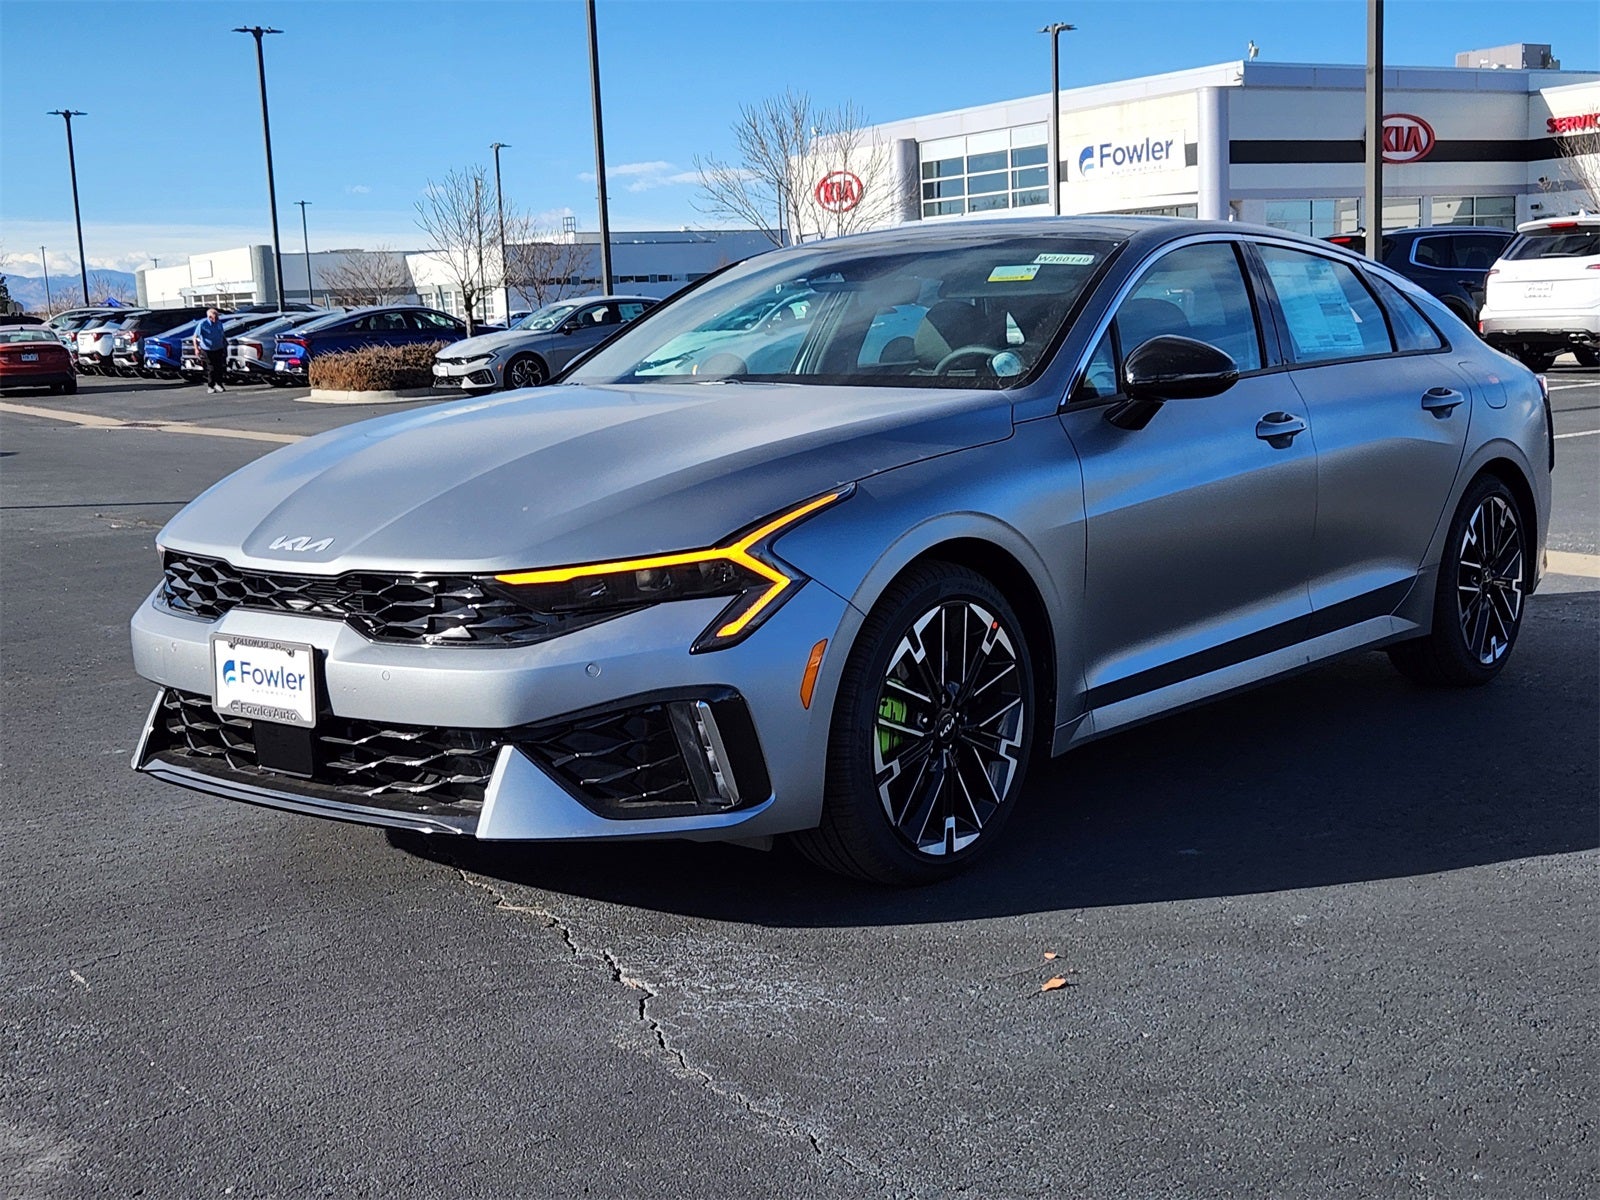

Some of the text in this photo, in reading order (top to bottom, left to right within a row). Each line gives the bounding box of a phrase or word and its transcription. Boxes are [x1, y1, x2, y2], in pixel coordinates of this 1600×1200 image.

[1099, 137, 1173, 168] Fowler
[824, 180, 855, 204] KIA
[269, 535, 335, 552] KIA
[240, 660, 305, 691] Fowler
[240, 702, 297, 721] FowlerAuto
